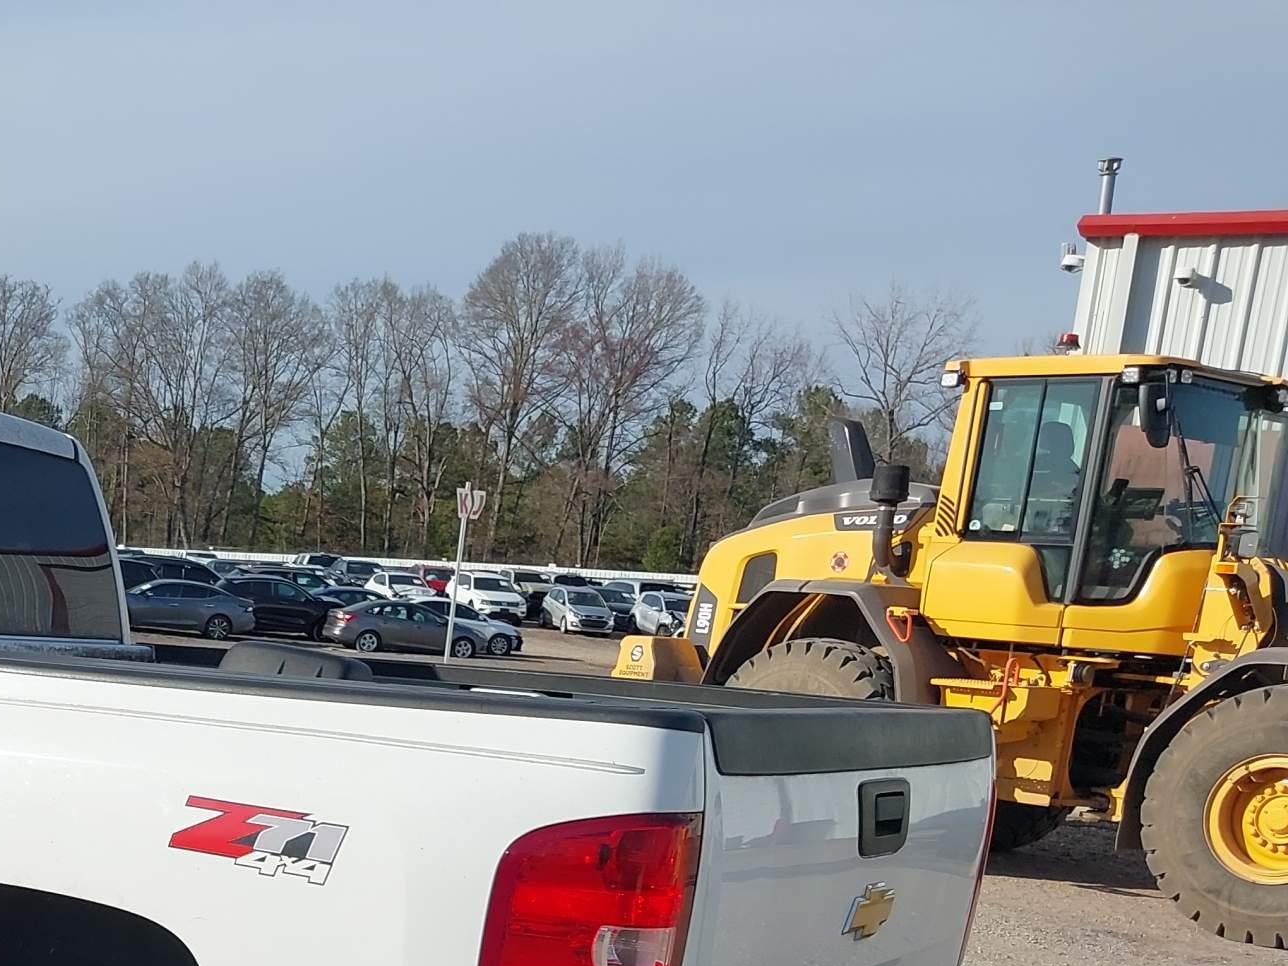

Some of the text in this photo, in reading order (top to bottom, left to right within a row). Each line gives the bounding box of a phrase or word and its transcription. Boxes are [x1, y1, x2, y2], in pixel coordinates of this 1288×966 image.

[842, 514, 908, 526] VOLO
[695, 603, 713, 634] L90H
[168, 795, 349, 865] Z71
